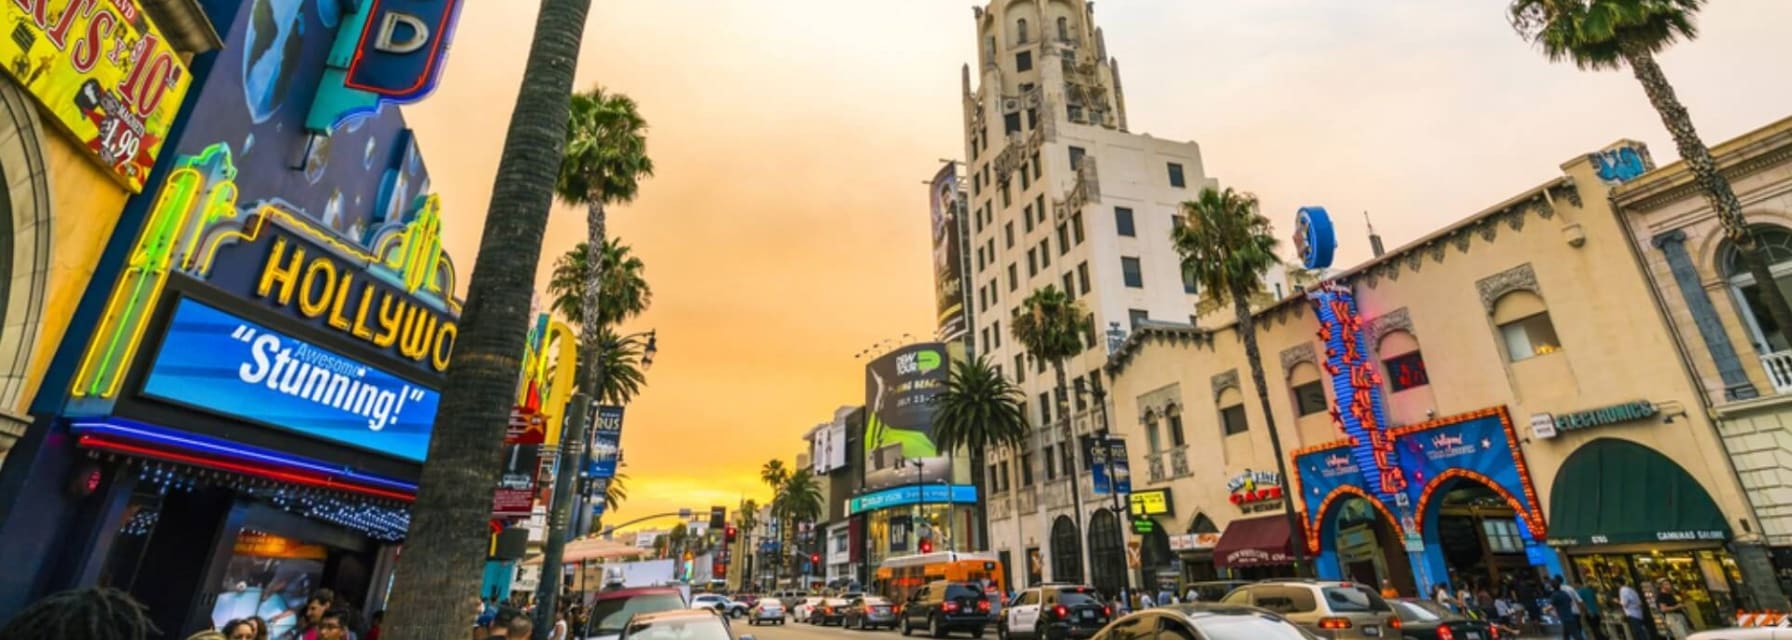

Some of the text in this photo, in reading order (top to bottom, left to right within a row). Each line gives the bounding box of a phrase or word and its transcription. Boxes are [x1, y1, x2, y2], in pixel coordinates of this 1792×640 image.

[374, 12, 428, 54] D
[914, 378, 944, 389] BEAC
[1555, 401, 1653, 431] ELECTRONICS
